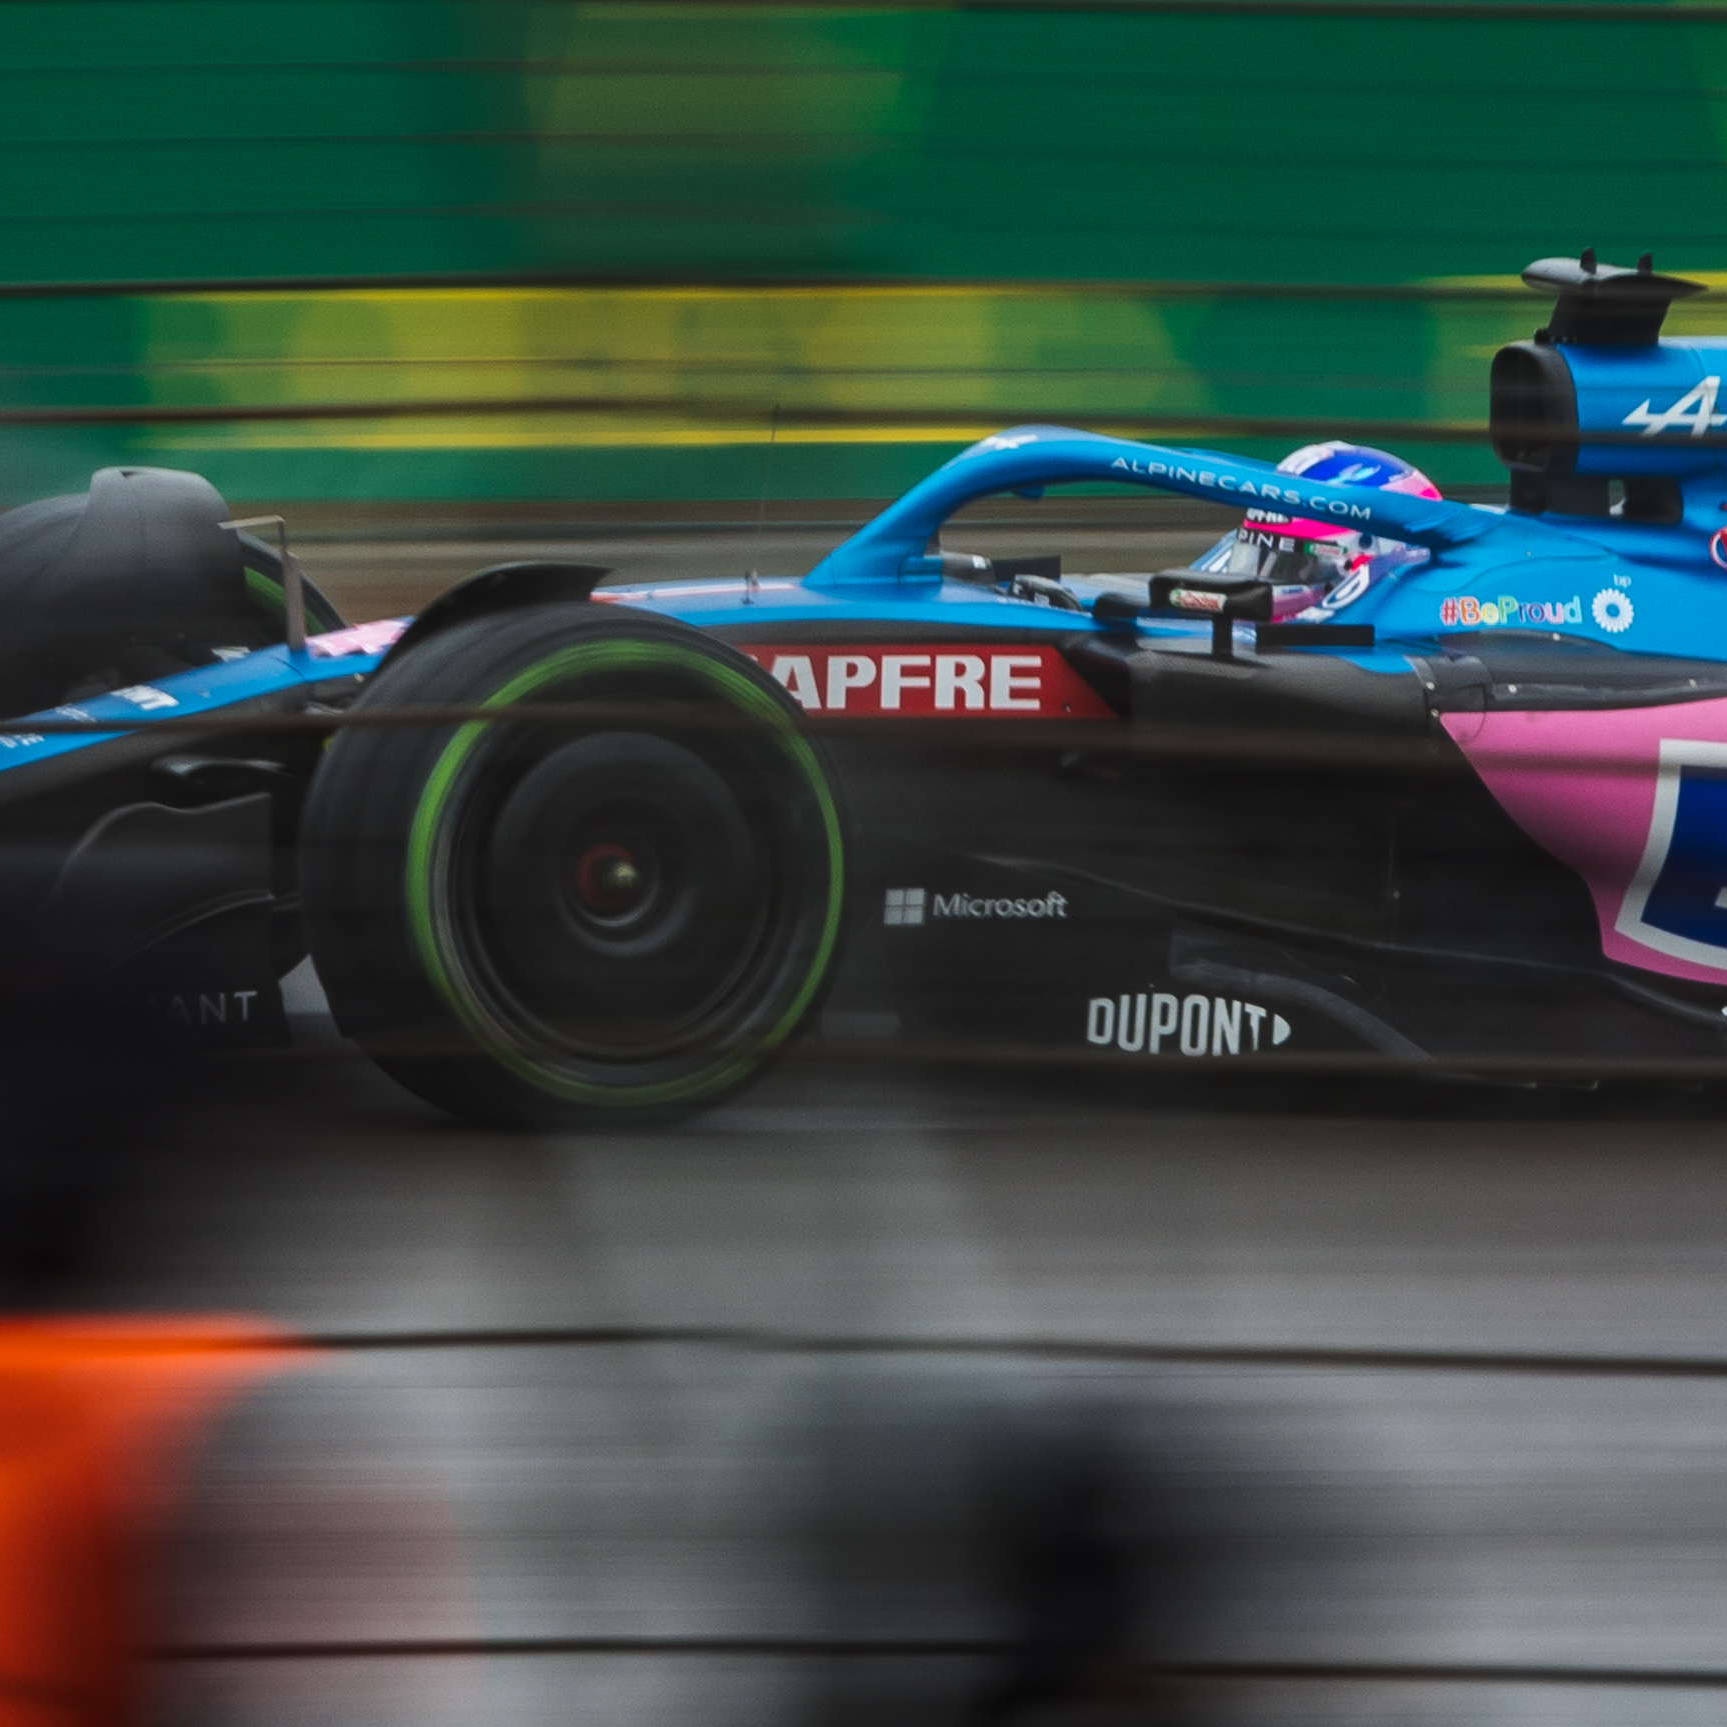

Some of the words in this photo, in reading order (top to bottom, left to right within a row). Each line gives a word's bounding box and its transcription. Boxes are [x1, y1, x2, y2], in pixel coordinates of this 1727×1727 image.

[1111, 456, 1372, 521] ALPINECARS.COM
[1439, 595, 1583, 626] #BeProud
[747, 654, 1042, 709] APFRE
[933, 891, 1068, 918] Microsoft
